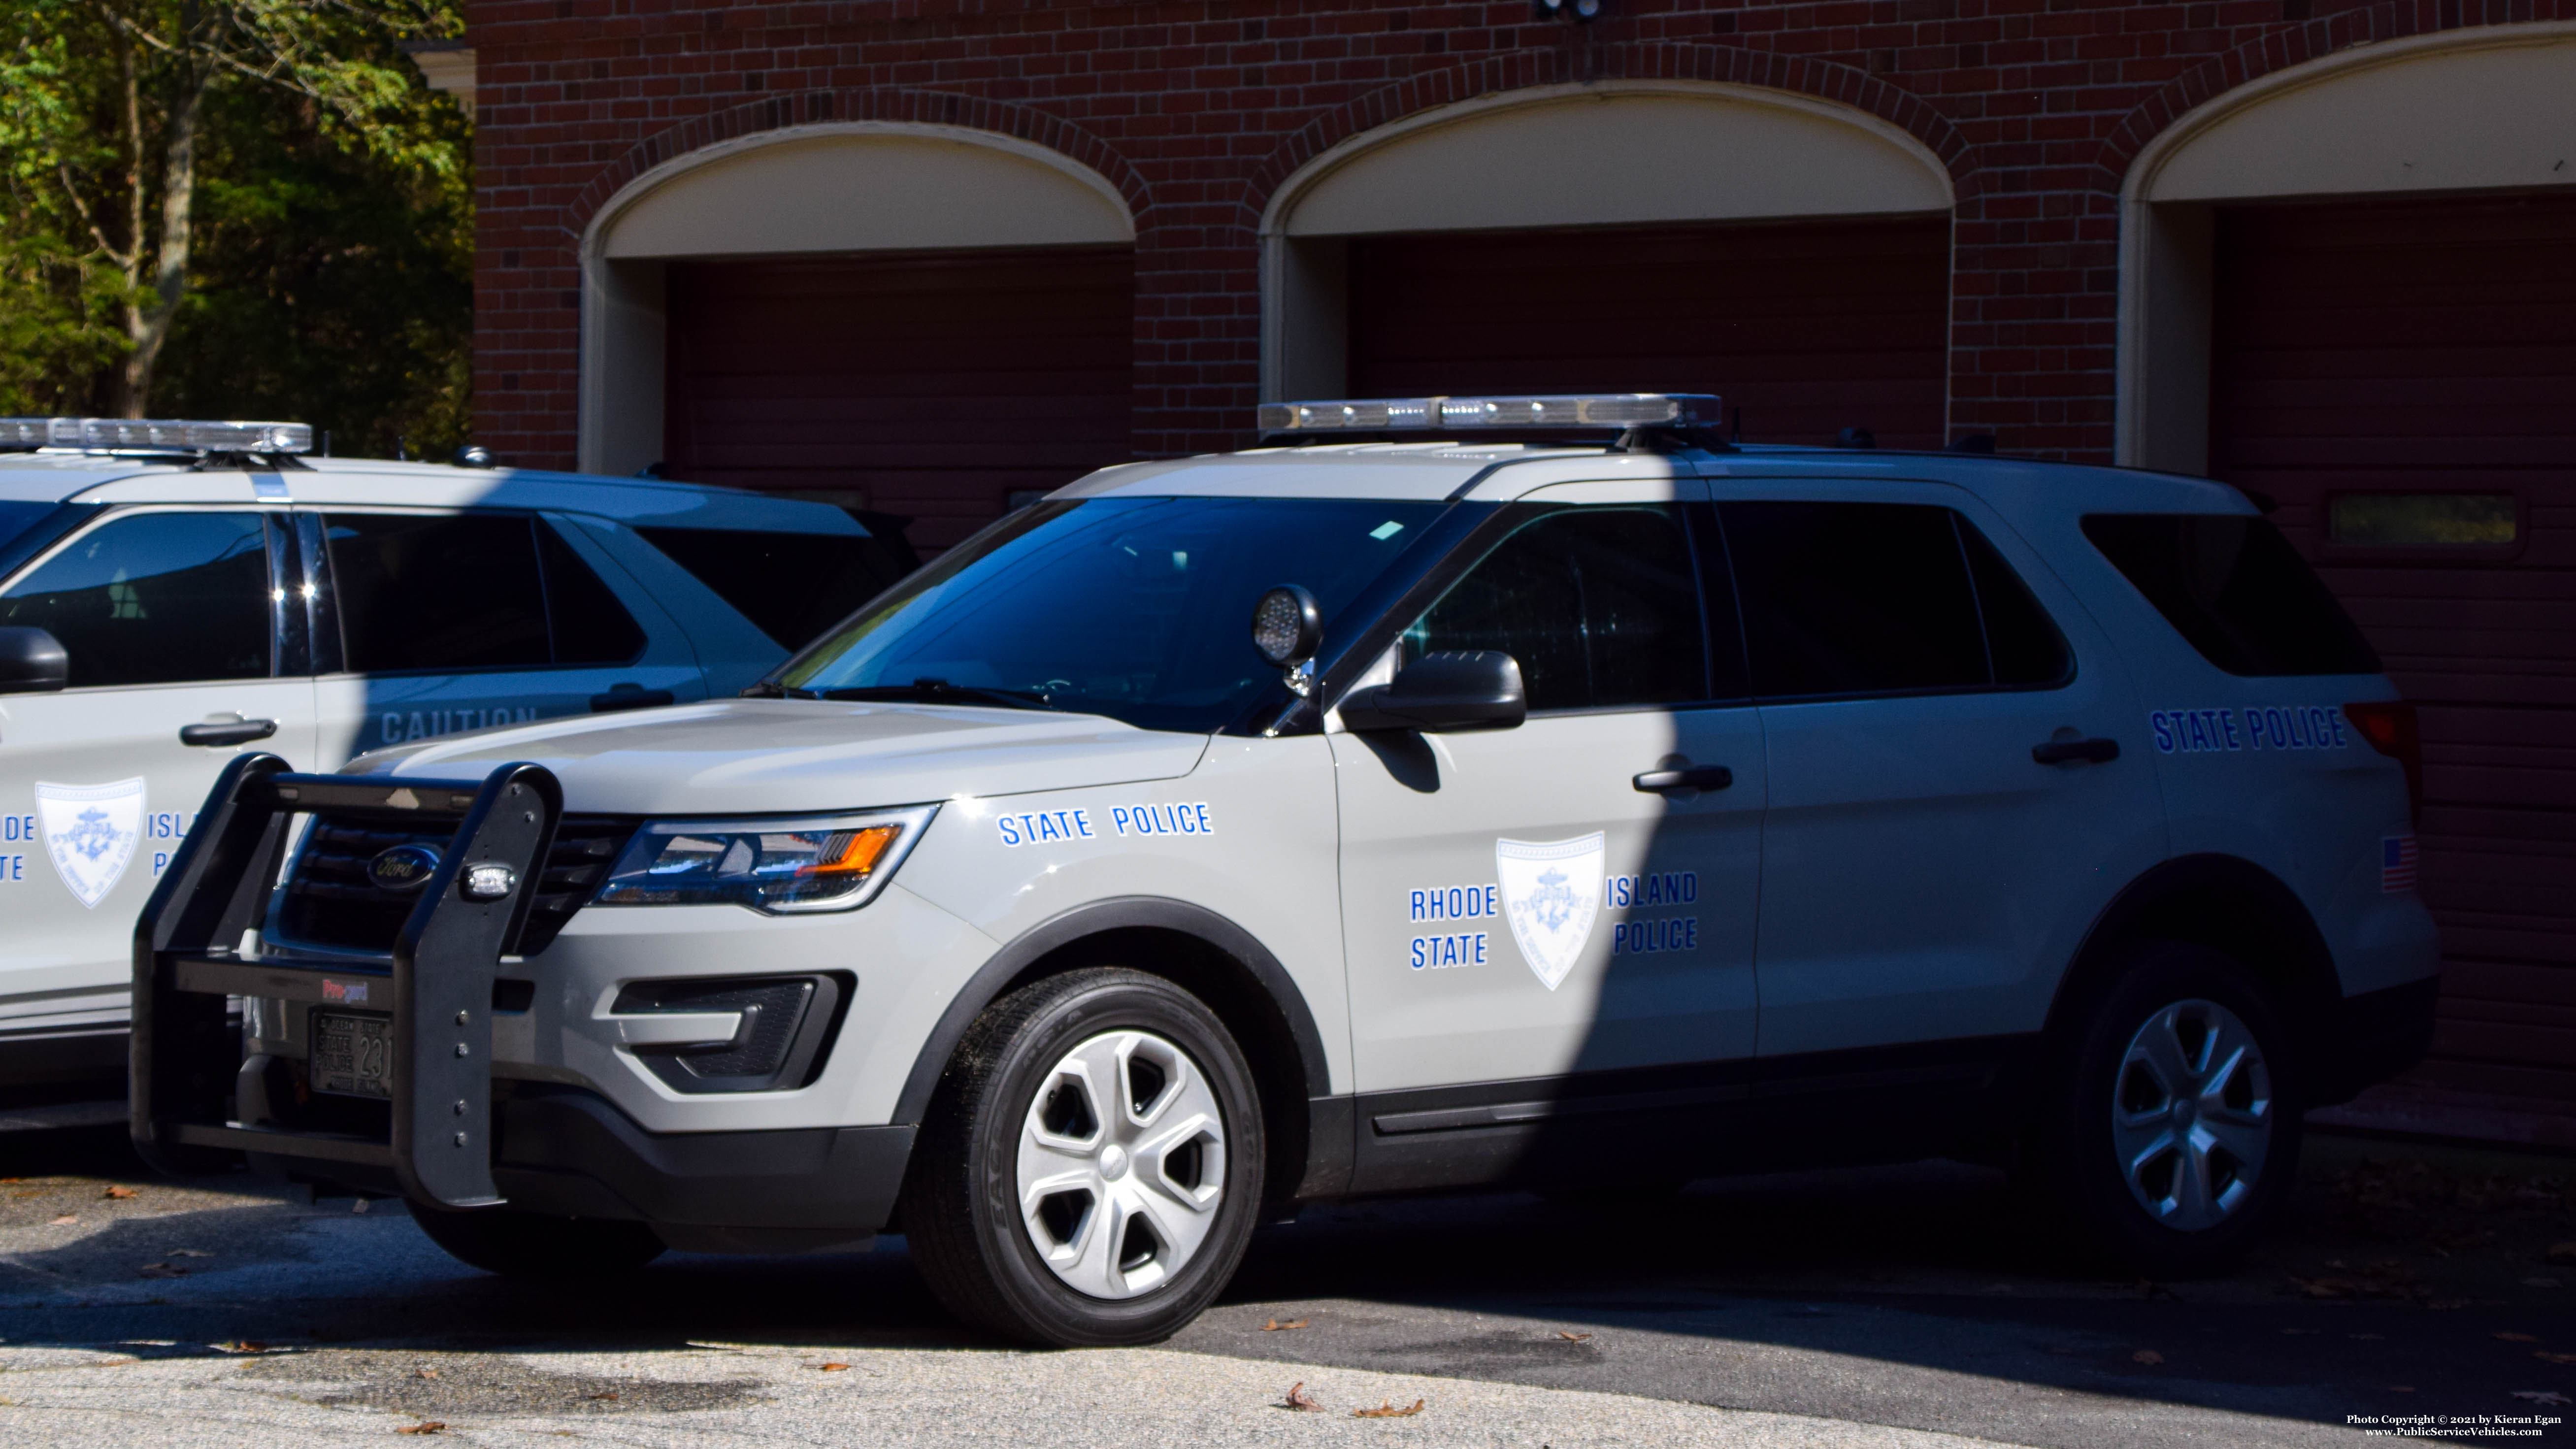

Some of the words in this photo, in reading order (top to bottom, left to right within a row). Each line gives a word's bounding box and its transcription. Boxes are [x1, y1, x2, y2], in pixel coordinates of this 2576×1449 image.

[2151, 709, 2240, 752] STATE
[2246, 708, 2346, 749] POLICE
[148, 814, 199, 838] ISL
[998, 810, 1093, 845] STATE
[1112, 804, 1211, 834] POLICE
[376, 856, 418, 878] Ford
[1411, 886, 1496, 920] RHODE
[1608, 872, 1696, 907] ISLAND
[1412, 934, 1486, 968] STATE
[1615, 919, 1696, 954] POLICE
[319, 1034, 351, 1053] STATE
[315, 1053, 355, 1073] POLICE
